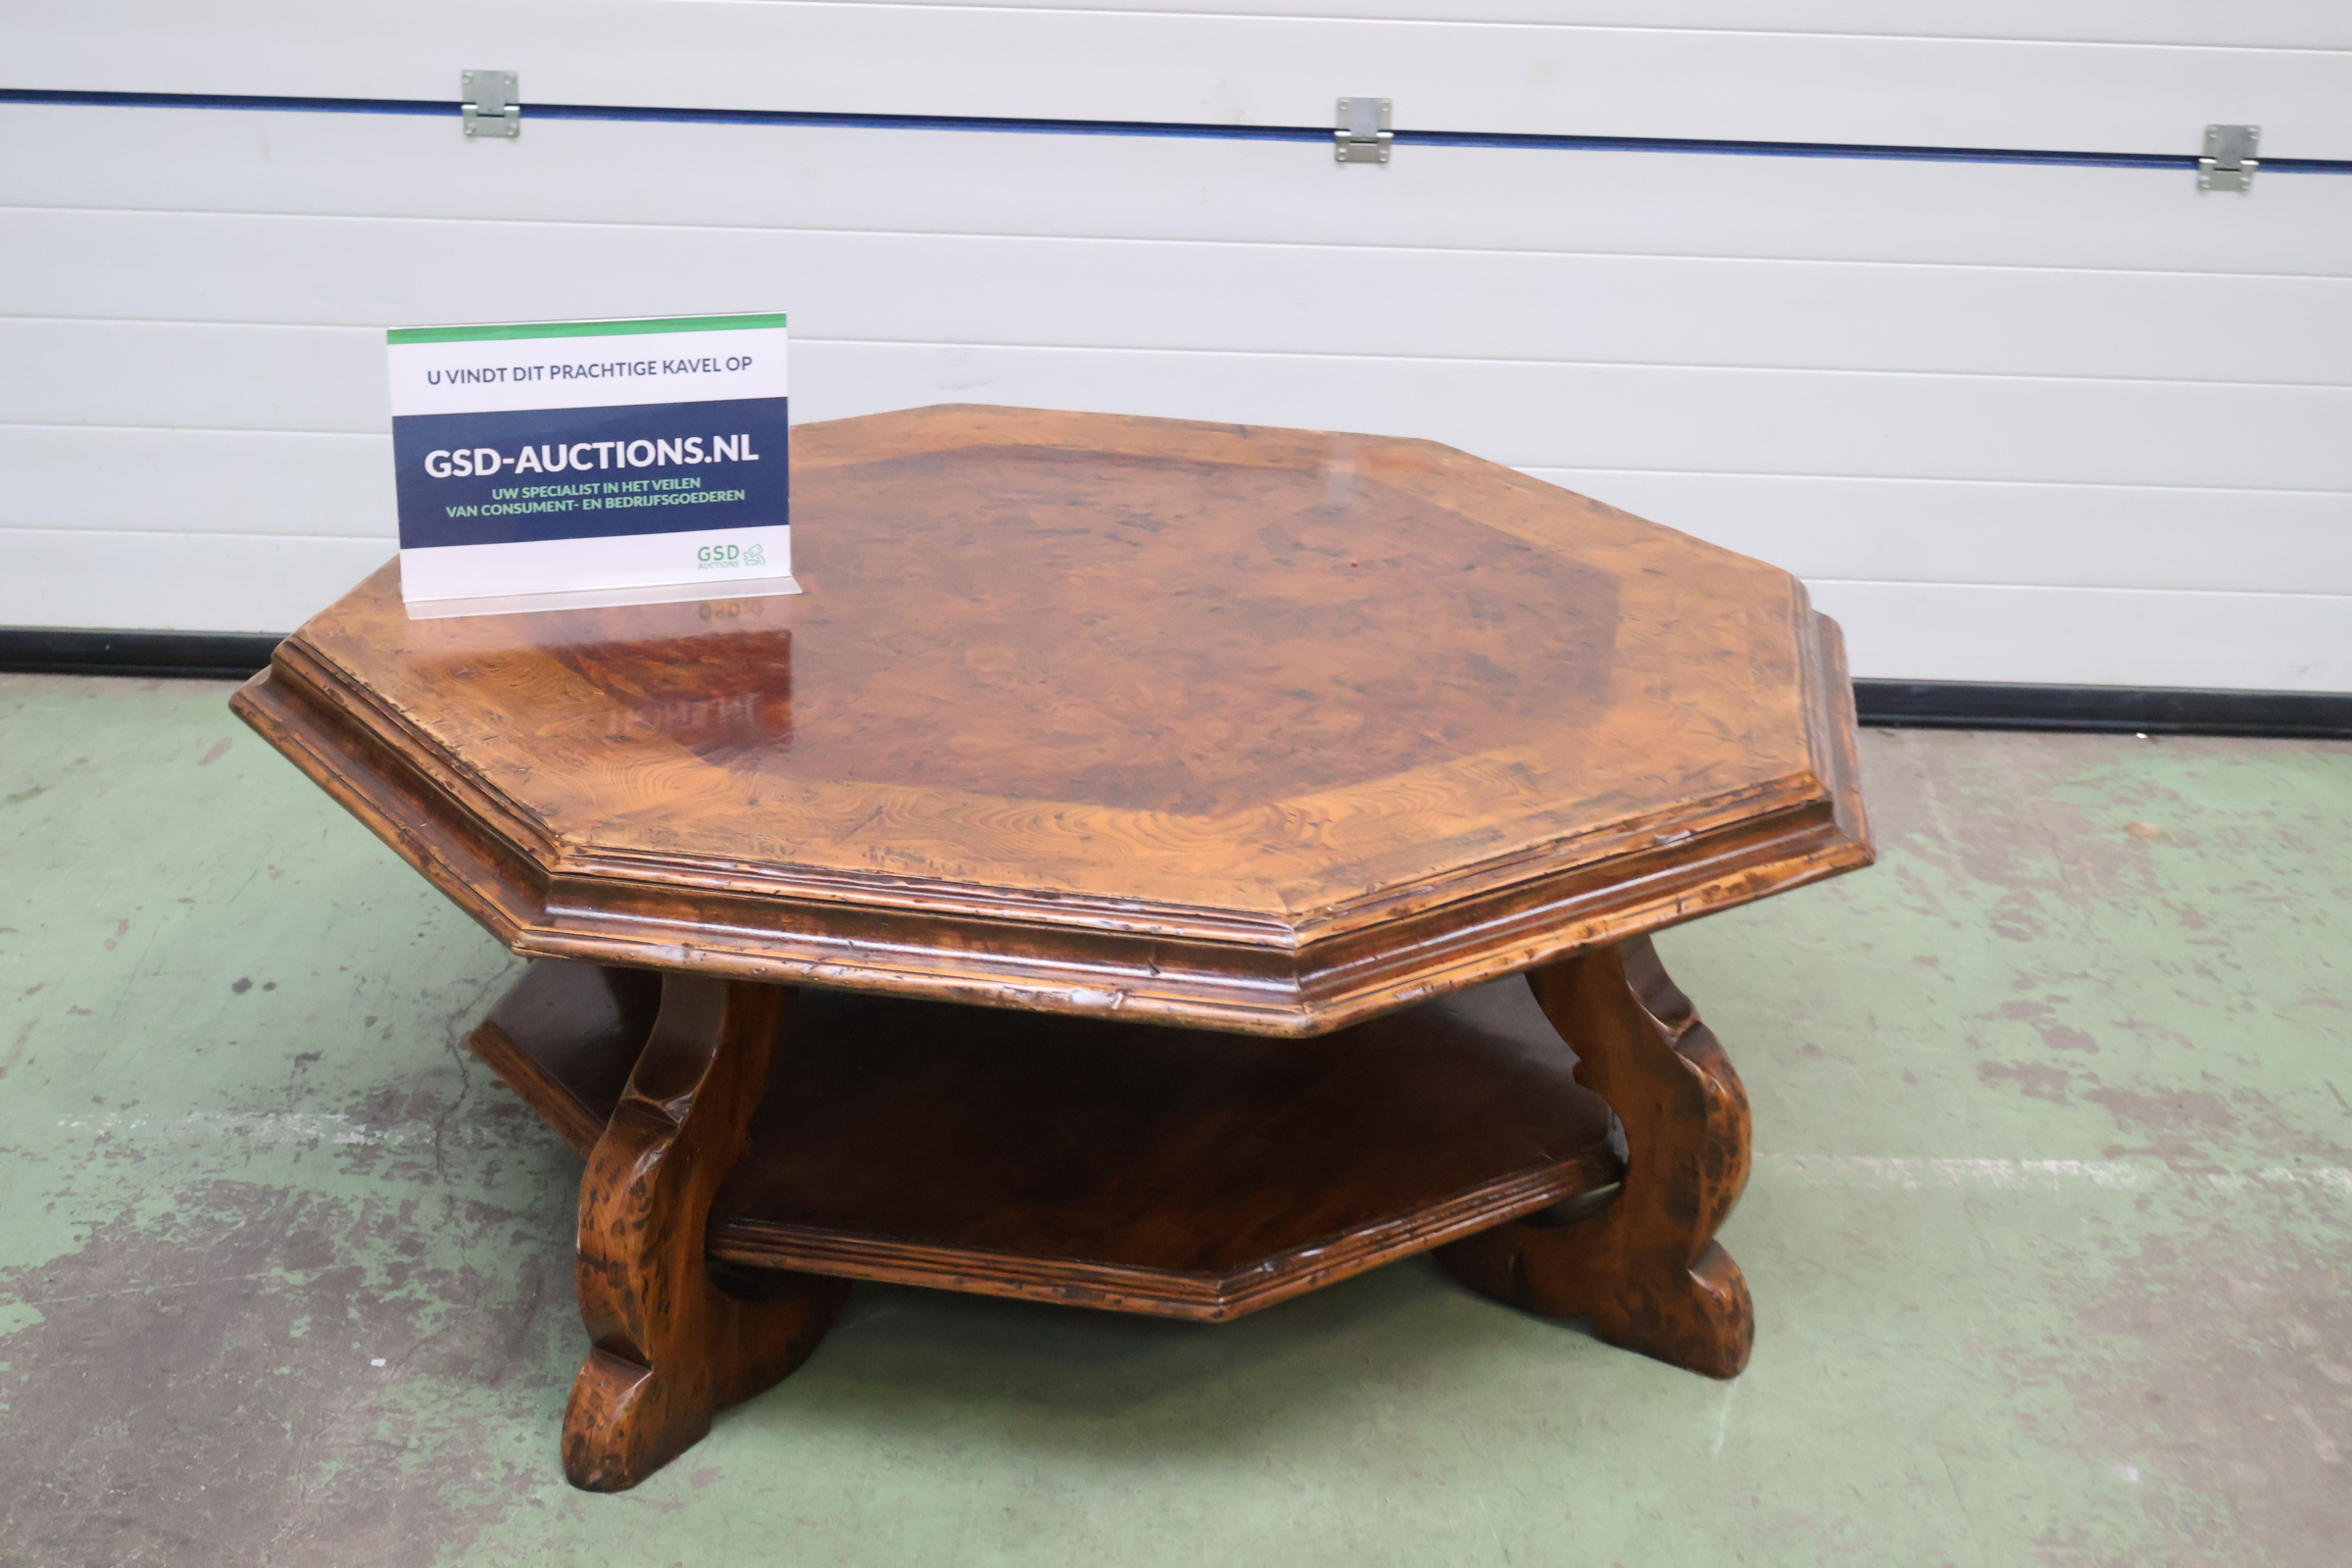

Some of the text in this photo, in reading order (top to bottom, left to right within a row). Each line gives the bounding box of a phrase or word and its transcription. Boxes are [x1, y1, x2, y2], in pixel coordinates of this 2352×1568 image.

[428, 356, 753, 385] U VINDT DIT PRACHTIGE KAVEL OP
[423, 434, 760, 478] GSD-AUCTIONS.NL
[492, 477, 701, 501] UW SPECIALIST IN HET VEILEN
[446, 490, 745, 518] VAN CONSUMENT- EN BEDRIJFSGOEDEREN
[698, 545, 740, 562] GSD
